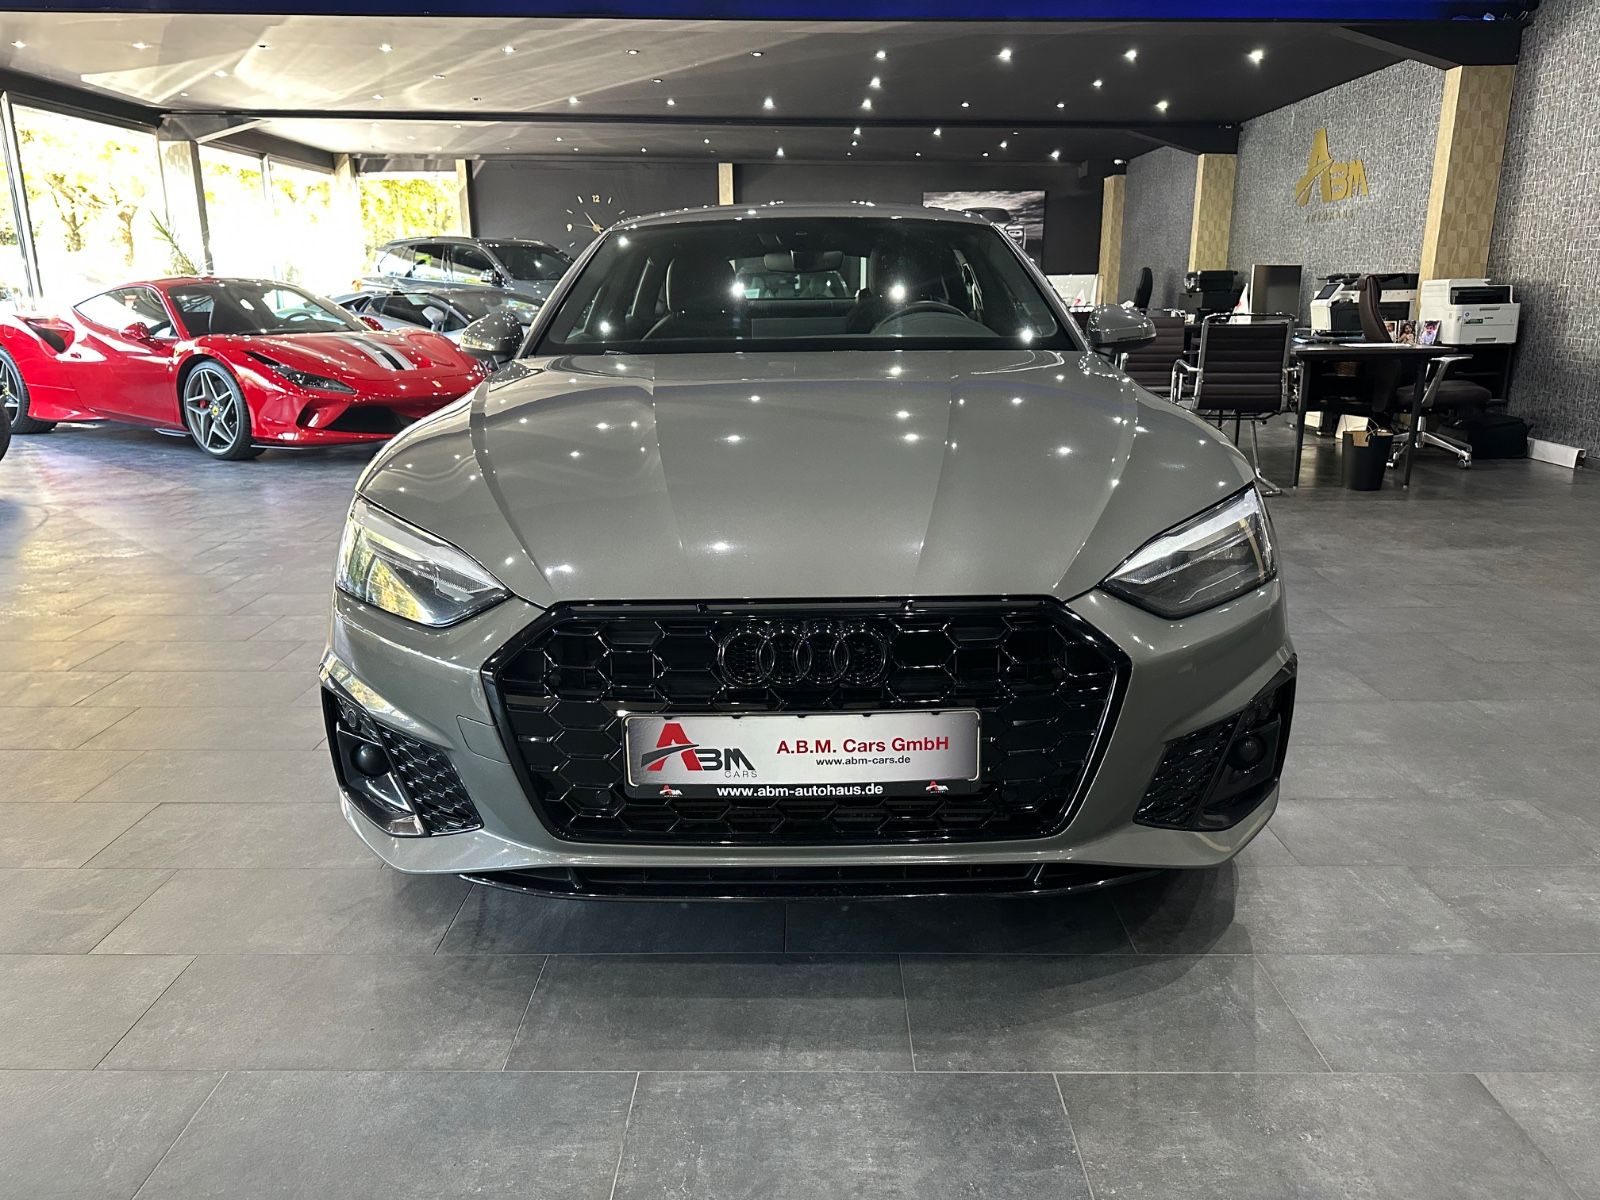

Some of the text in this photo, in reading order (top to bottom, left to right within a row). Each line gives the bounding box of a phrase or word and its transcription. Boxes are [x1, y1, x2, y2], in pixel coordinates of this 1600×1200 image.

[1295, 127, 1369, 208] ABM
[592, 195, 600, 203] 12
[641, 723, 756, 772] ABM
[776, 736, 949, 754] A.B.M. Cars GmbH
[816, 755, 911, 766] www.abm-cars.de
[724, 770, 758, 778] CARS
[716, 783, 884, 797] www.abm-autohaus.de
